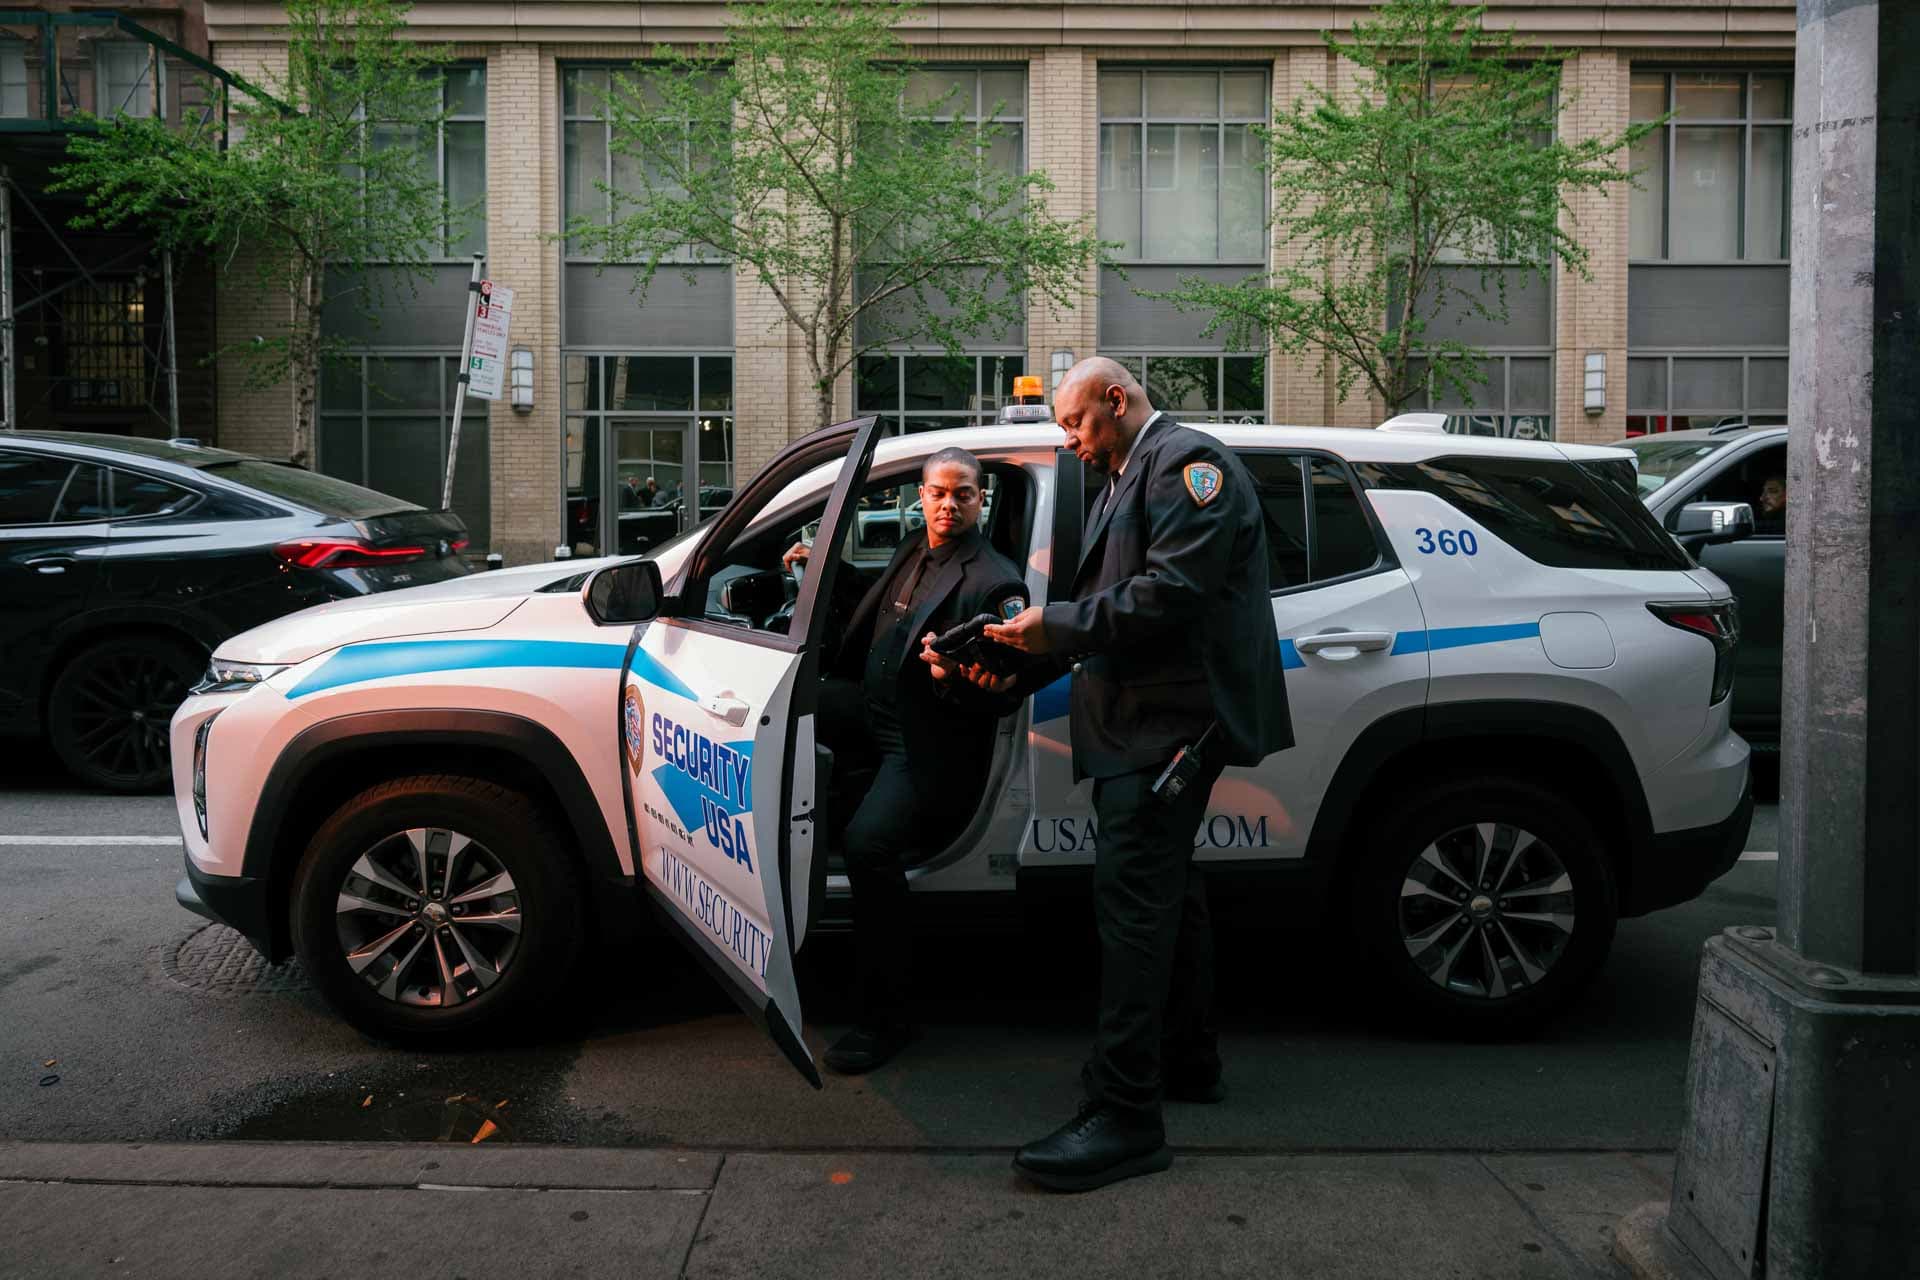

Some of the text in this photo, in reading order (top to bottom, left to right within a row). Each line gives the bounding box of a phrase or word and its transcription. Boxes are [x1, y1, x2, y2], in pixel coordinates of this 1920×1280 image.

[1415, 527, 1478, 556] 360
[652, 711, 749, 808] SECURITY
[701, 794, 754, 874] USA
[1033, 817, 1098, 852] USA
[661, 846, 771, 978] WWW.SECURITY
